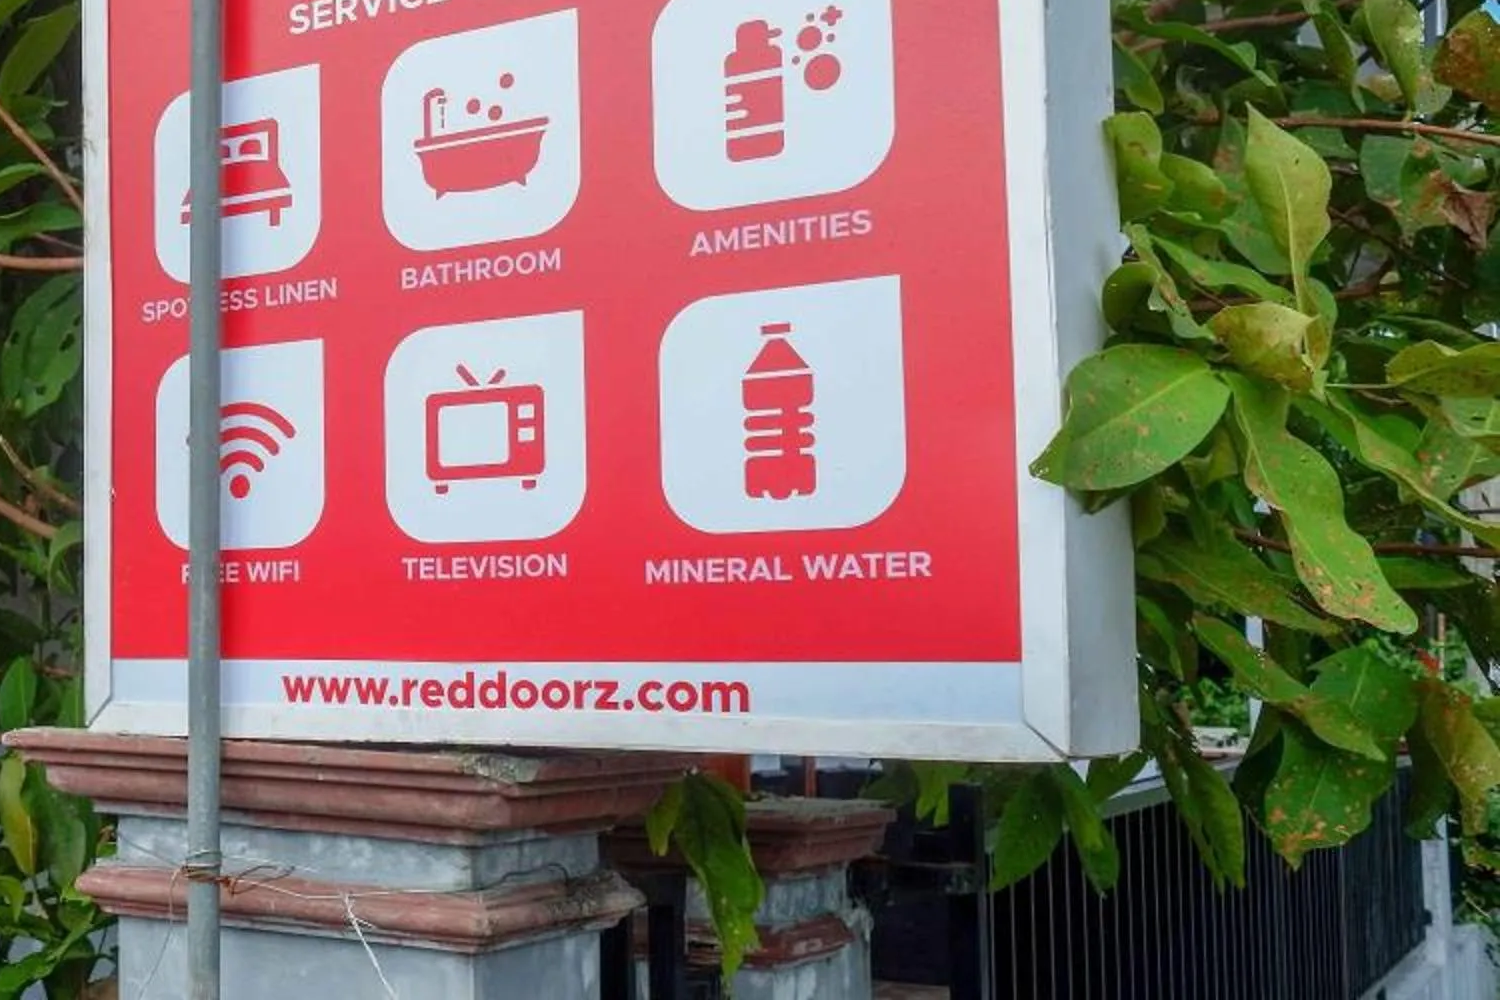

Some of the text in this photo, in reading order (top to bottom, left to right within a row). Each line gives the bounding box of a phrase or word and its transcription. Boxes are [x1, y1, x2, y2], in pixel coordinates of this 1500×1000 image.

[690, 209, 873, 257] AMENITIES
[401, 247, 562, 290] BATHROOM
[142, 277, 338, 323] SPOESS LINEN
[246, 559, 300, 583] WIFI
[402, 553, 568, 581] TELEVISION
[645, 551, 932, 584] MINERAL WATER
[282, 671, 751, 715] www.reddoorz.com
